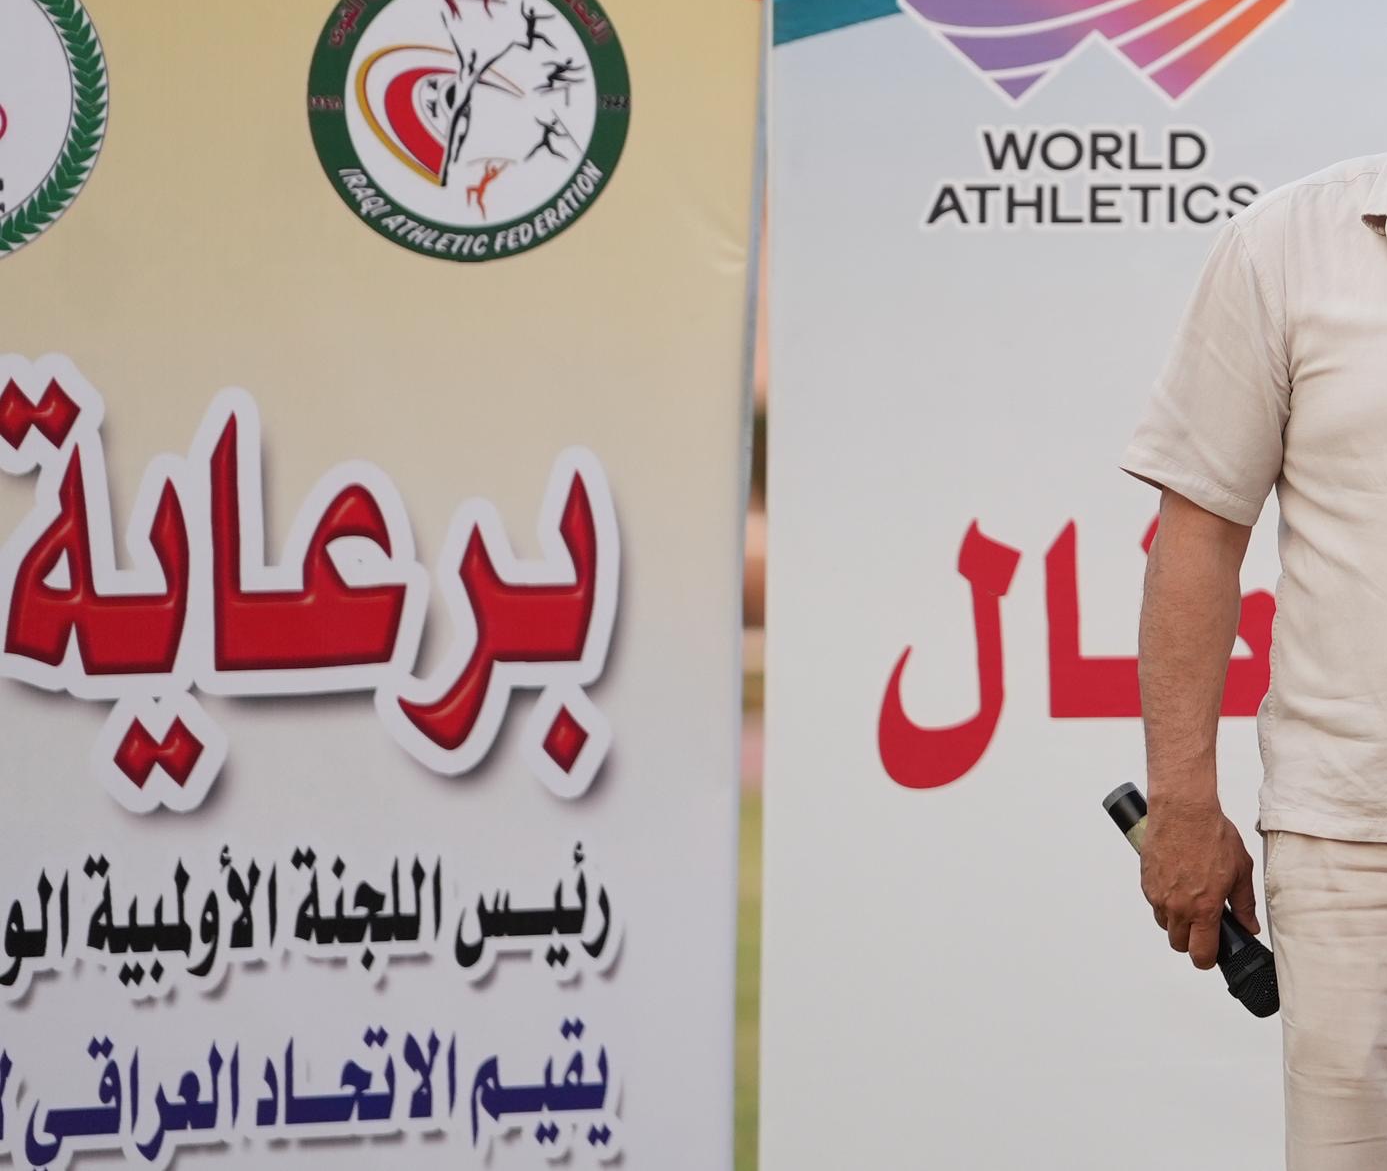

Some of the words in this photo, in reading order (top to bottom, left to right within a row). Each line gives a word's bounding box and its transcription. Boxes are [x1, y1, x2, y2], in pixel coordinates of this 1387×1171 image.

[338, 167, 391, 218] IRAQI
[381, 213, 489, 256] ATHLETIC
[494, 157, 605, 253] FEDERATION
[926, 184, 1260, 225] ATHLETICS
[982, 131, 1208, 171] WORLD
[0, 376, 599, 789] برعاية
[82, 843, 278, 987] الأولمبية
[290, 844, 442, 972] اللجنة
[454, 839, 612, 969] رئيس
[24, 1034, 240, 1171] العراقي
[255, 1024, 456, 1127] الاتحاد
[470, 1015, 613, 1149] يقيم
